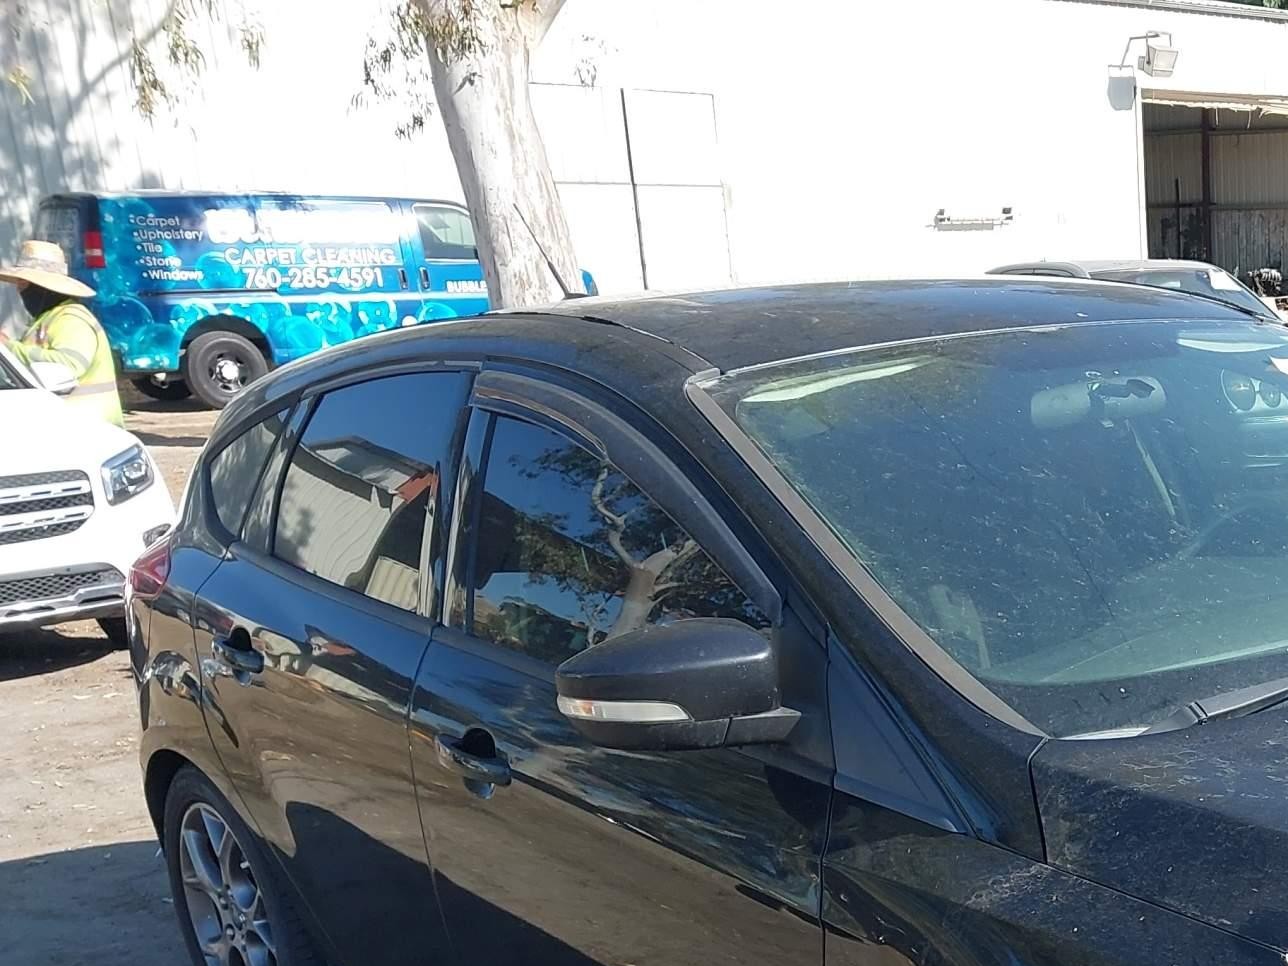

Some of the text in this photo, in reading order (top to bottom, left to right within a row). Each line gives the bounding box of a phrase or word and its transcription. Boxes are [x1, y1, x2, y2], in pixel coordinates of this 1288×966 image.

[136, 215, 180, 228] Carpet
[140, 229, 203, 241] Upholstery
[141, 243, 162, 253] Tile
[225, 247, 396, 266] CARPET CLEANING
[244, 268, 384, 289] 760-285-4591
